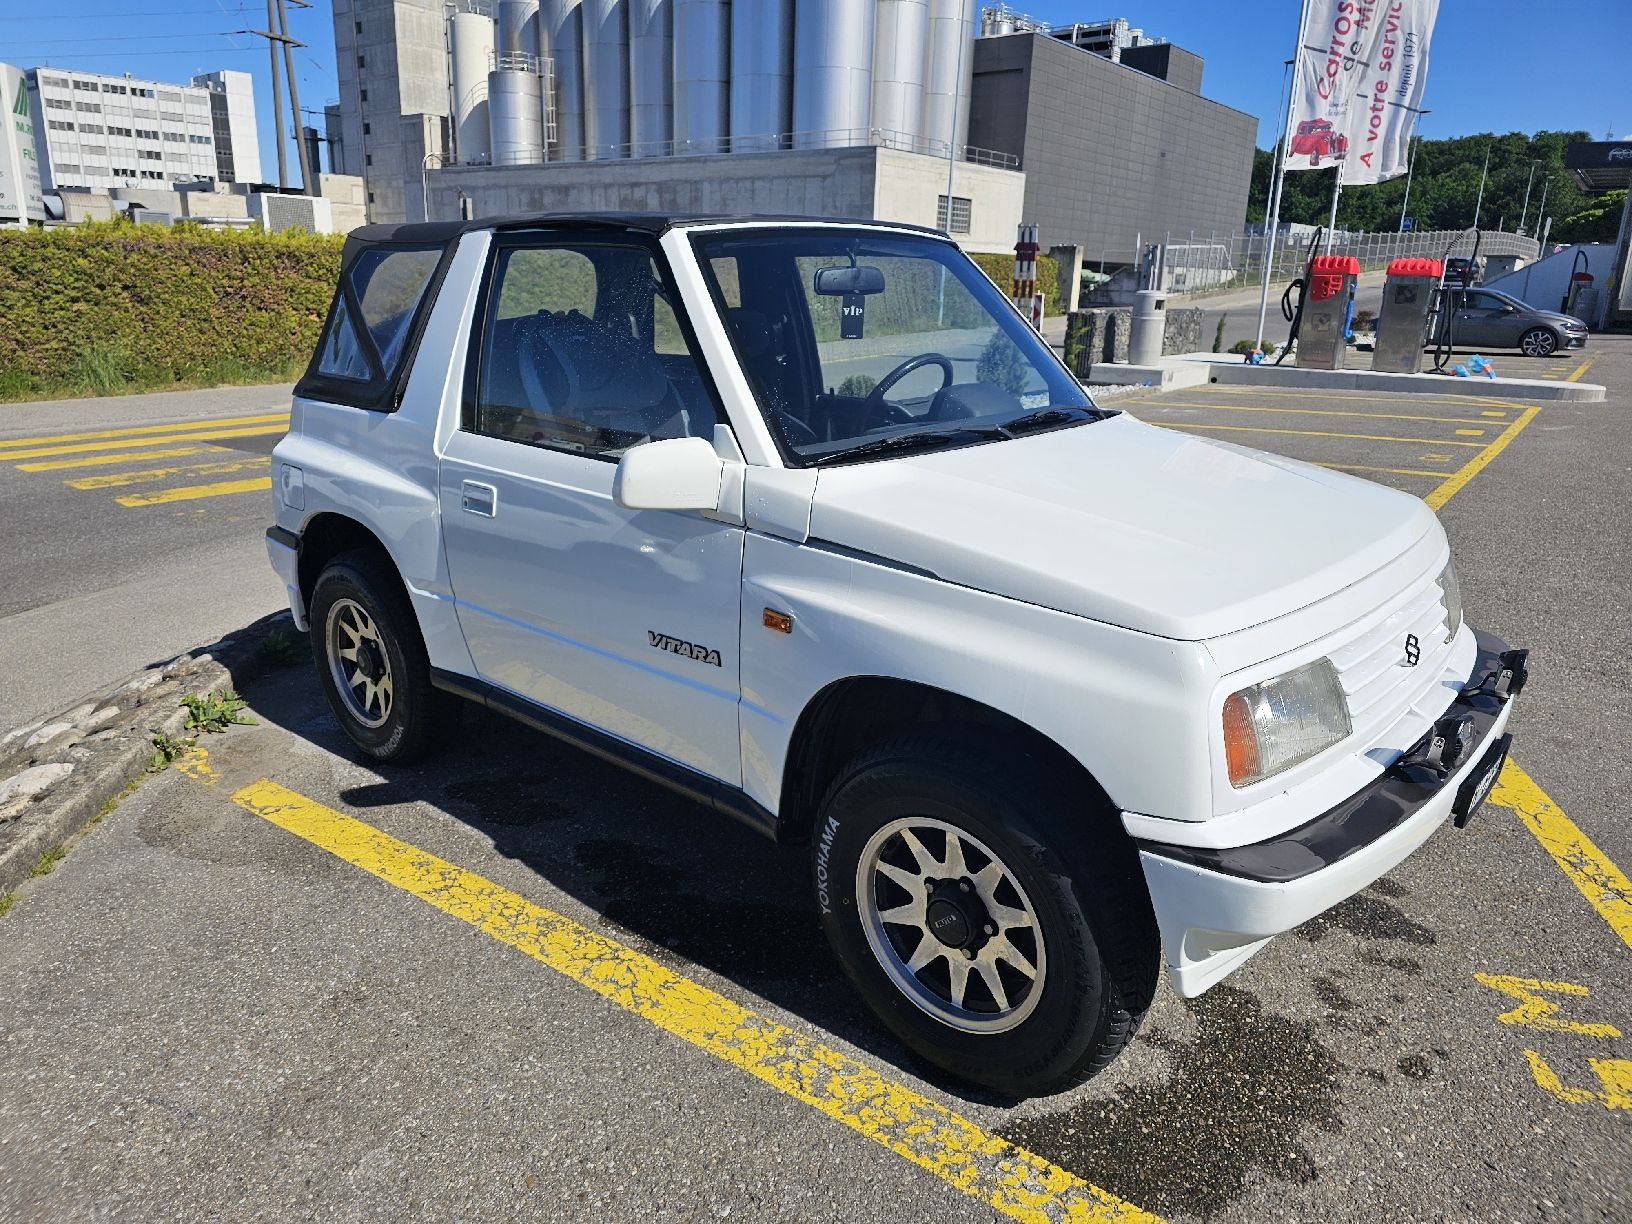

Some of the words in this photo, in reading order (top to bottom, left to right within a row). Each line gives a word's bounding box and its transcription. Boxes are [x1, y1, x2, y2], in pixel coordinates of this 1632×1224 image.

[1343, 40, 1363, 72] de
[1366, 80, 1388, 141] votre
[1360, 152, 1373, 168] A
[647, 630, 722, 667] VITARA
[817, 815, 841, 915] YOKOHAMA
